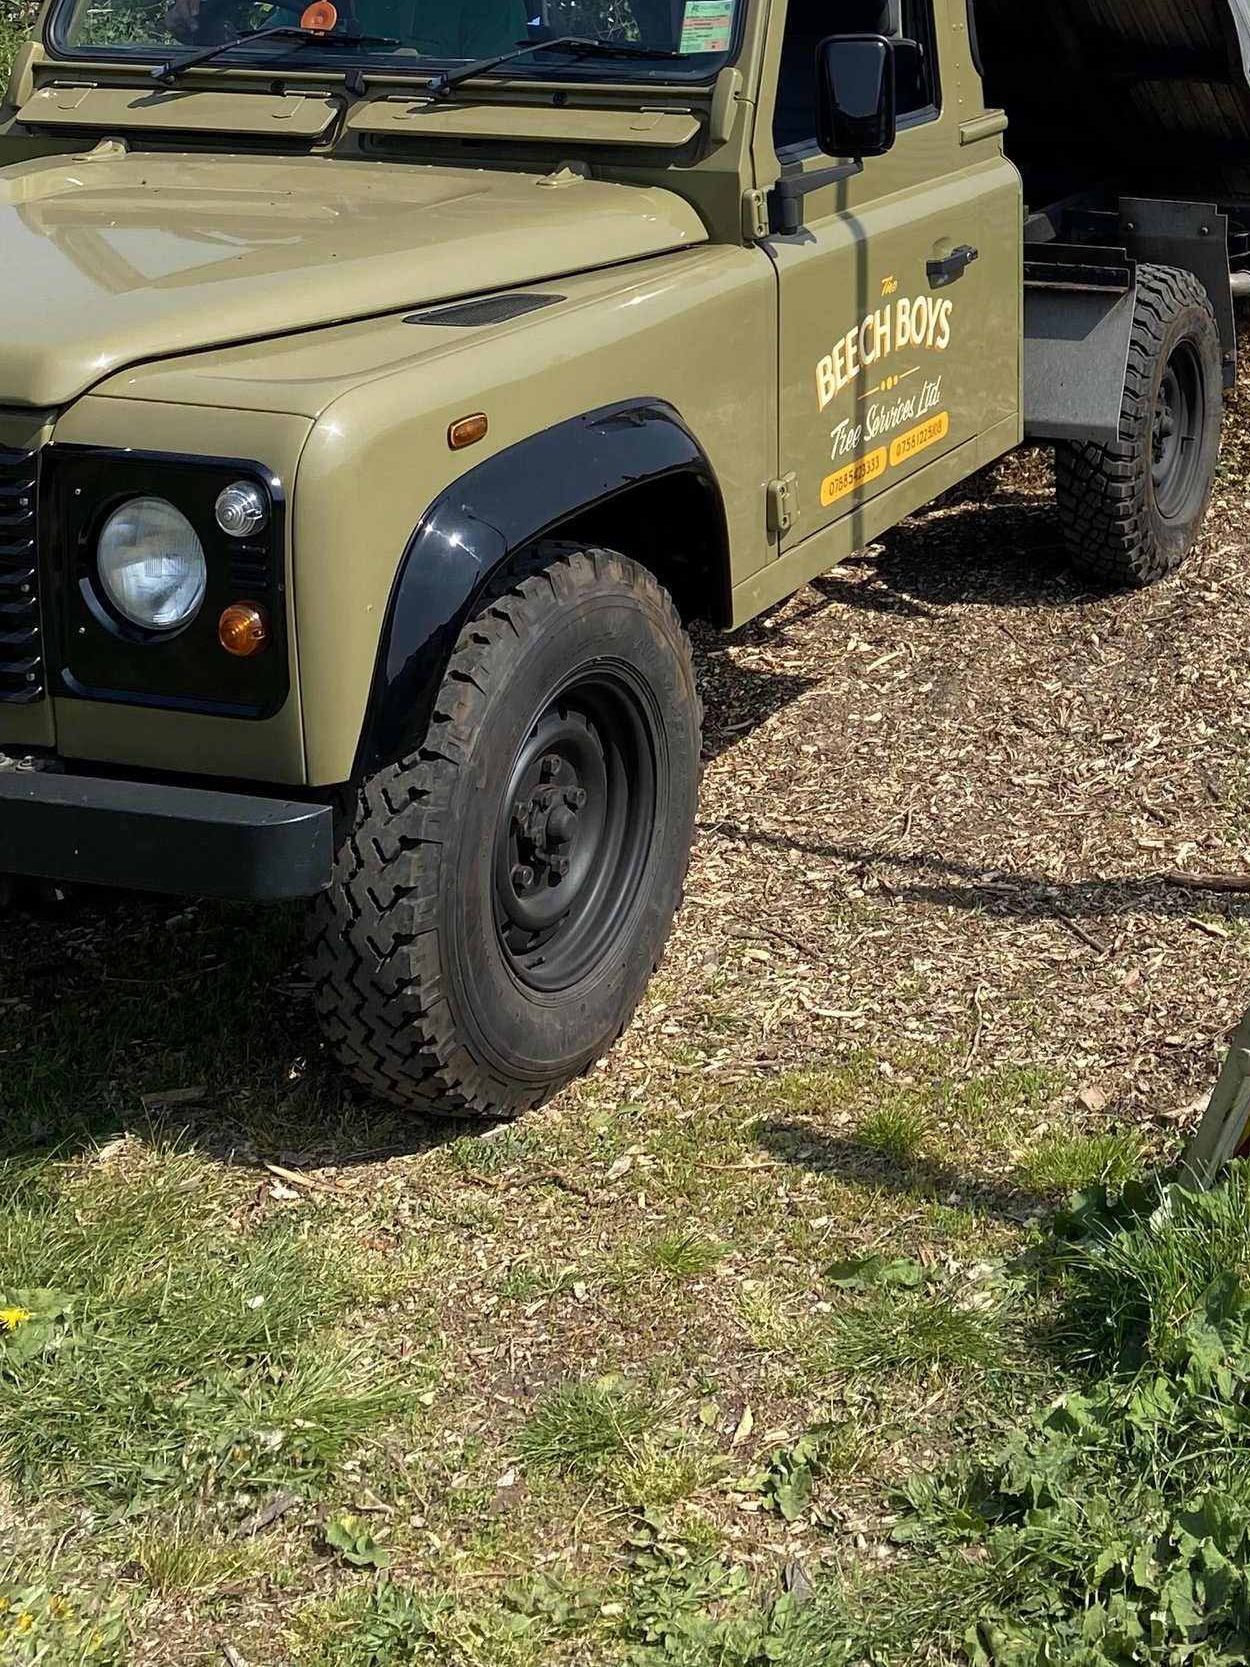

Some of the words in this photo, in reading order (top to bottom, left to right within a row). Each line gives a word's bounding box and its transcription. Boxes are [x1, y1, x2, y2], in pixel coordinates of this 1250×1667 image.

[881, 275, 898, 297] The
[815, 304, 891, 413] BEECH
[895, 295, 953, 352] BOYS
[830, 417, 862, 461] Tree
[863, 395, 916, 442] Services
